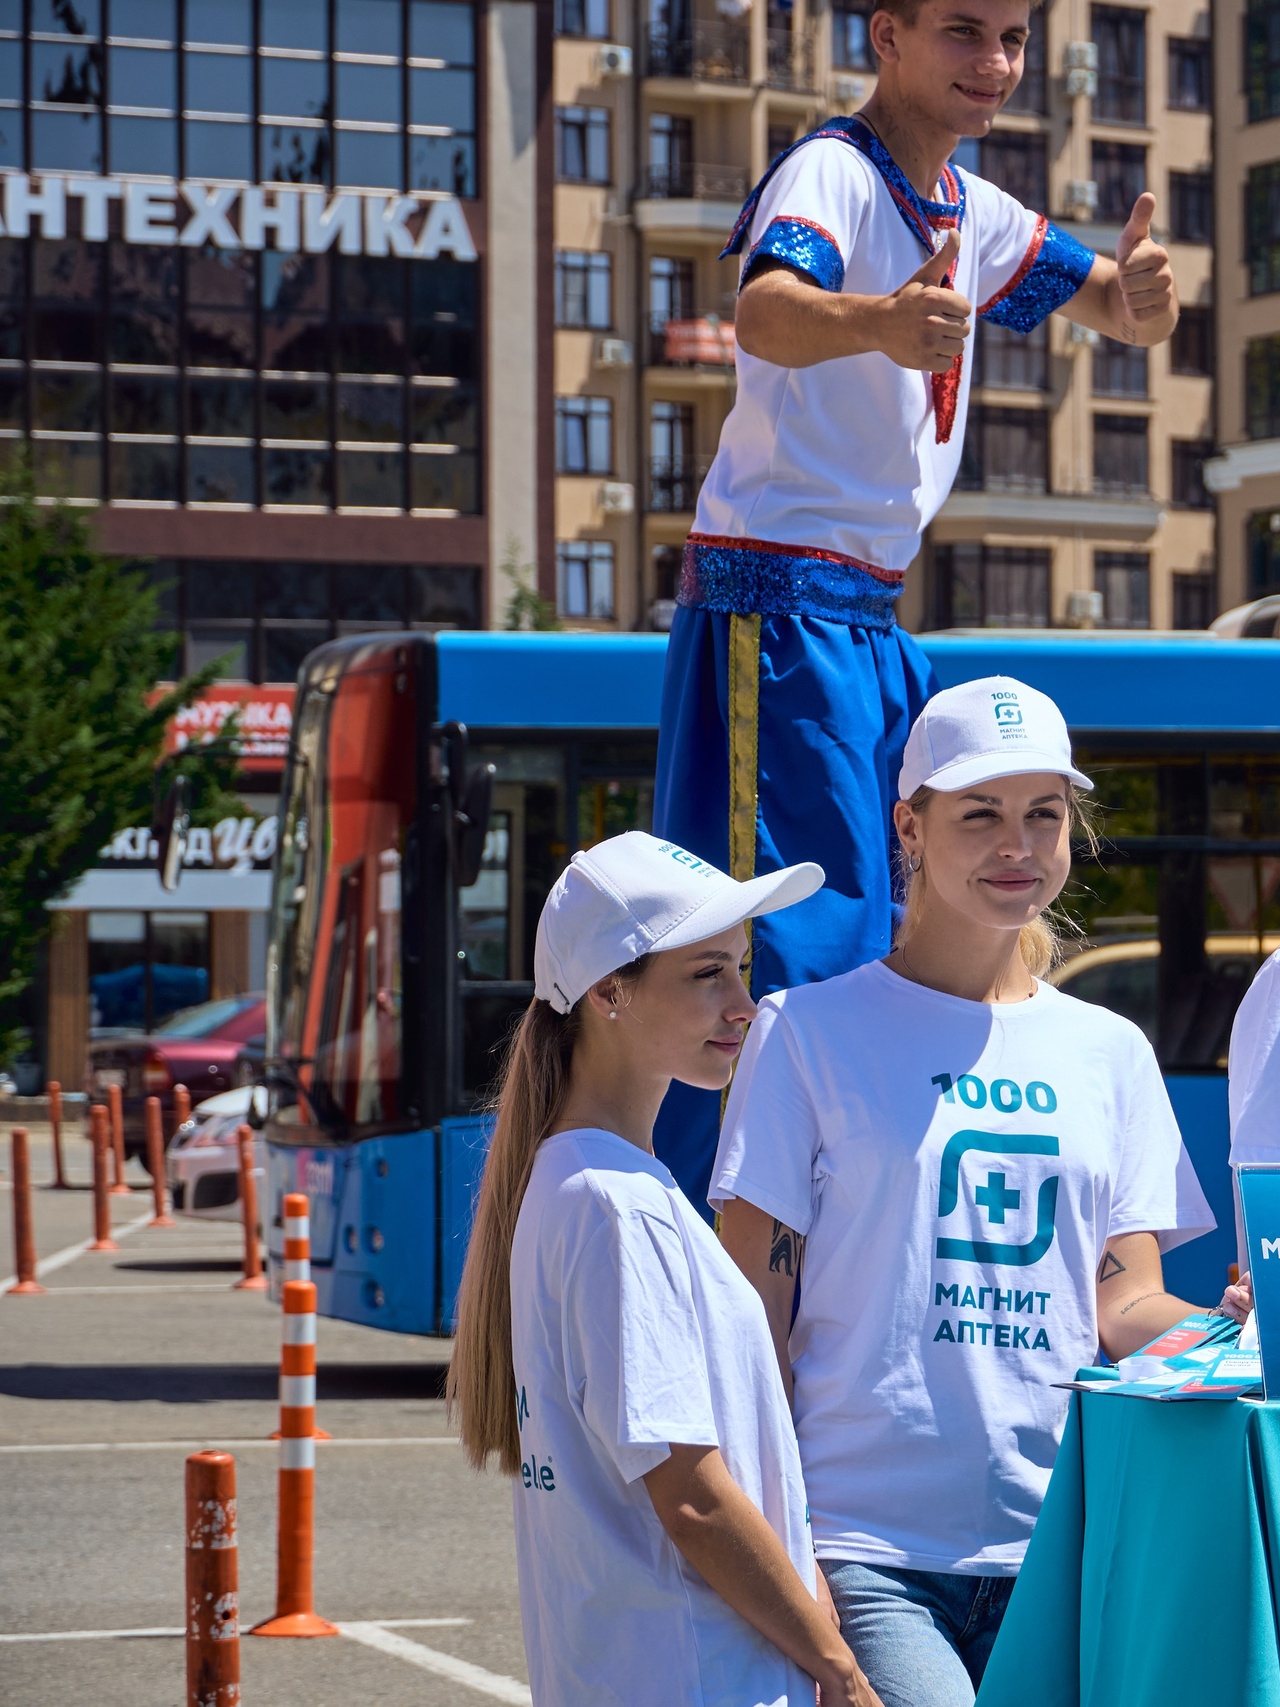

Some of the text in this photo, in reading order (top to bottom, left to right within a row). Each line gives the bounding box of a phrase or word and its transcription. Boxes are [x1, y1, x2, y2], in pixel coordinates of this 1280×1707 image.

[0, 173, 478, 261] НТЕХНИКА
[991, 691, 1018, 700] 1000
[931, 1072, 1058, 1114] 1000
[934, 1282, 1051, 1315] МАГНИТ
[933, 1319, 1051, 1352] АПТЕКА
